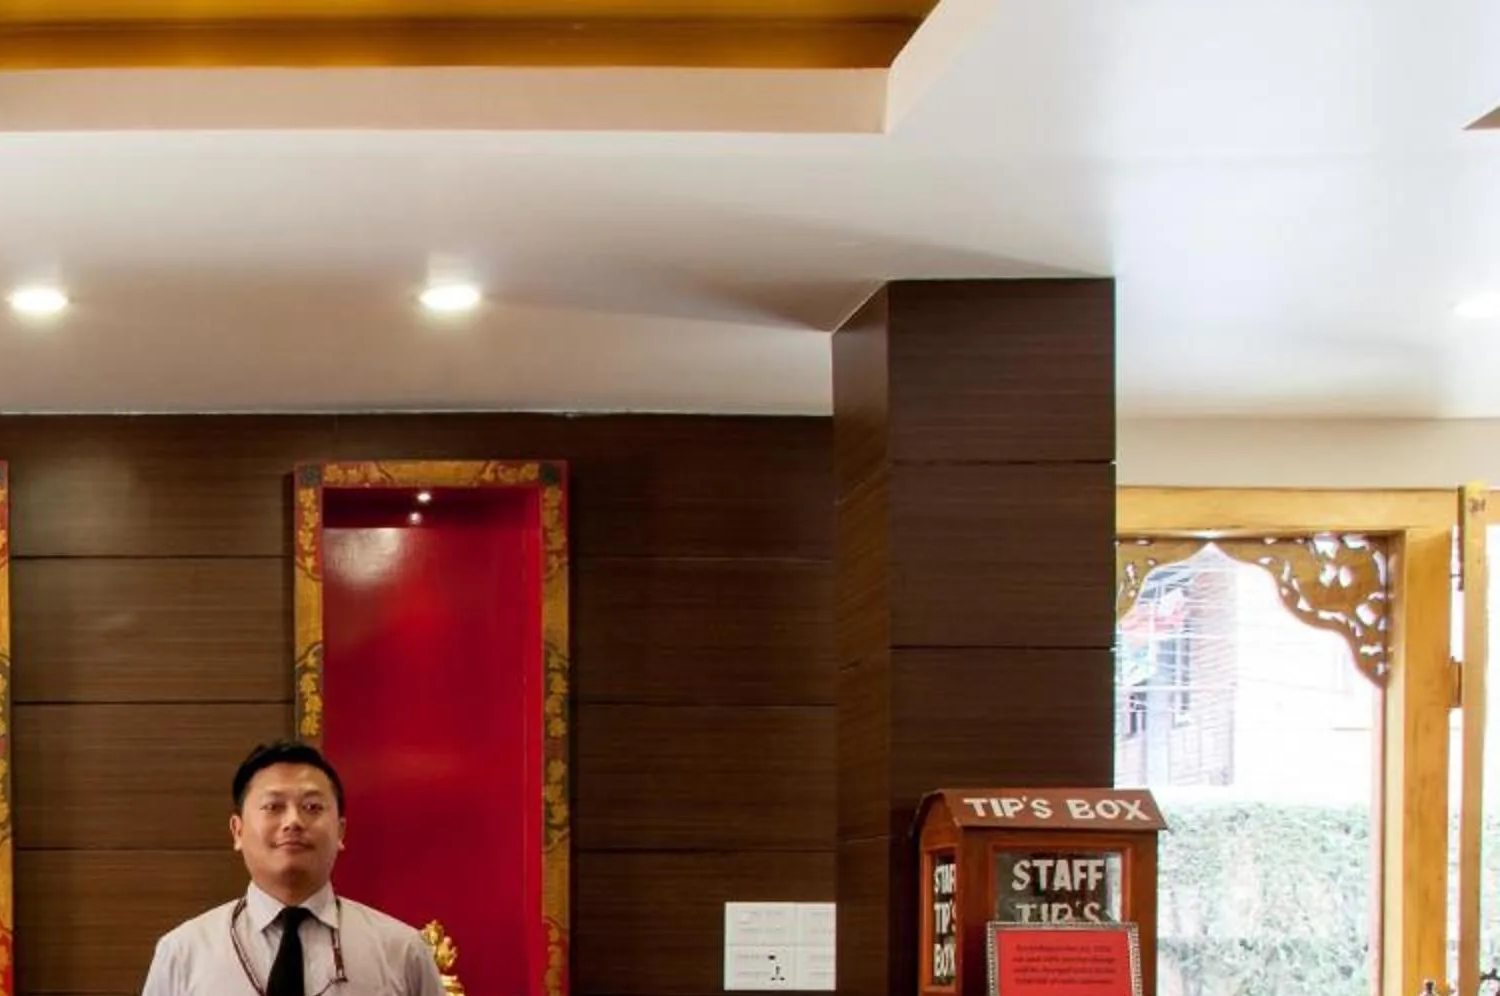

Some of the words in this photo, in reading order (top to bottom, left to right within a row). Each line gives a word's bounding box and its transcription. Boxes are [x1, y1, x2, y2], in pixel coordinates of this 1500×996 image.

[964, 797, 1053, 819] TIP'S
[1066, 799, 1150, 821] BOX
[1011, 859, 1104, 891] STAFF
[1016, 901, 1100, 924] TIP'S
